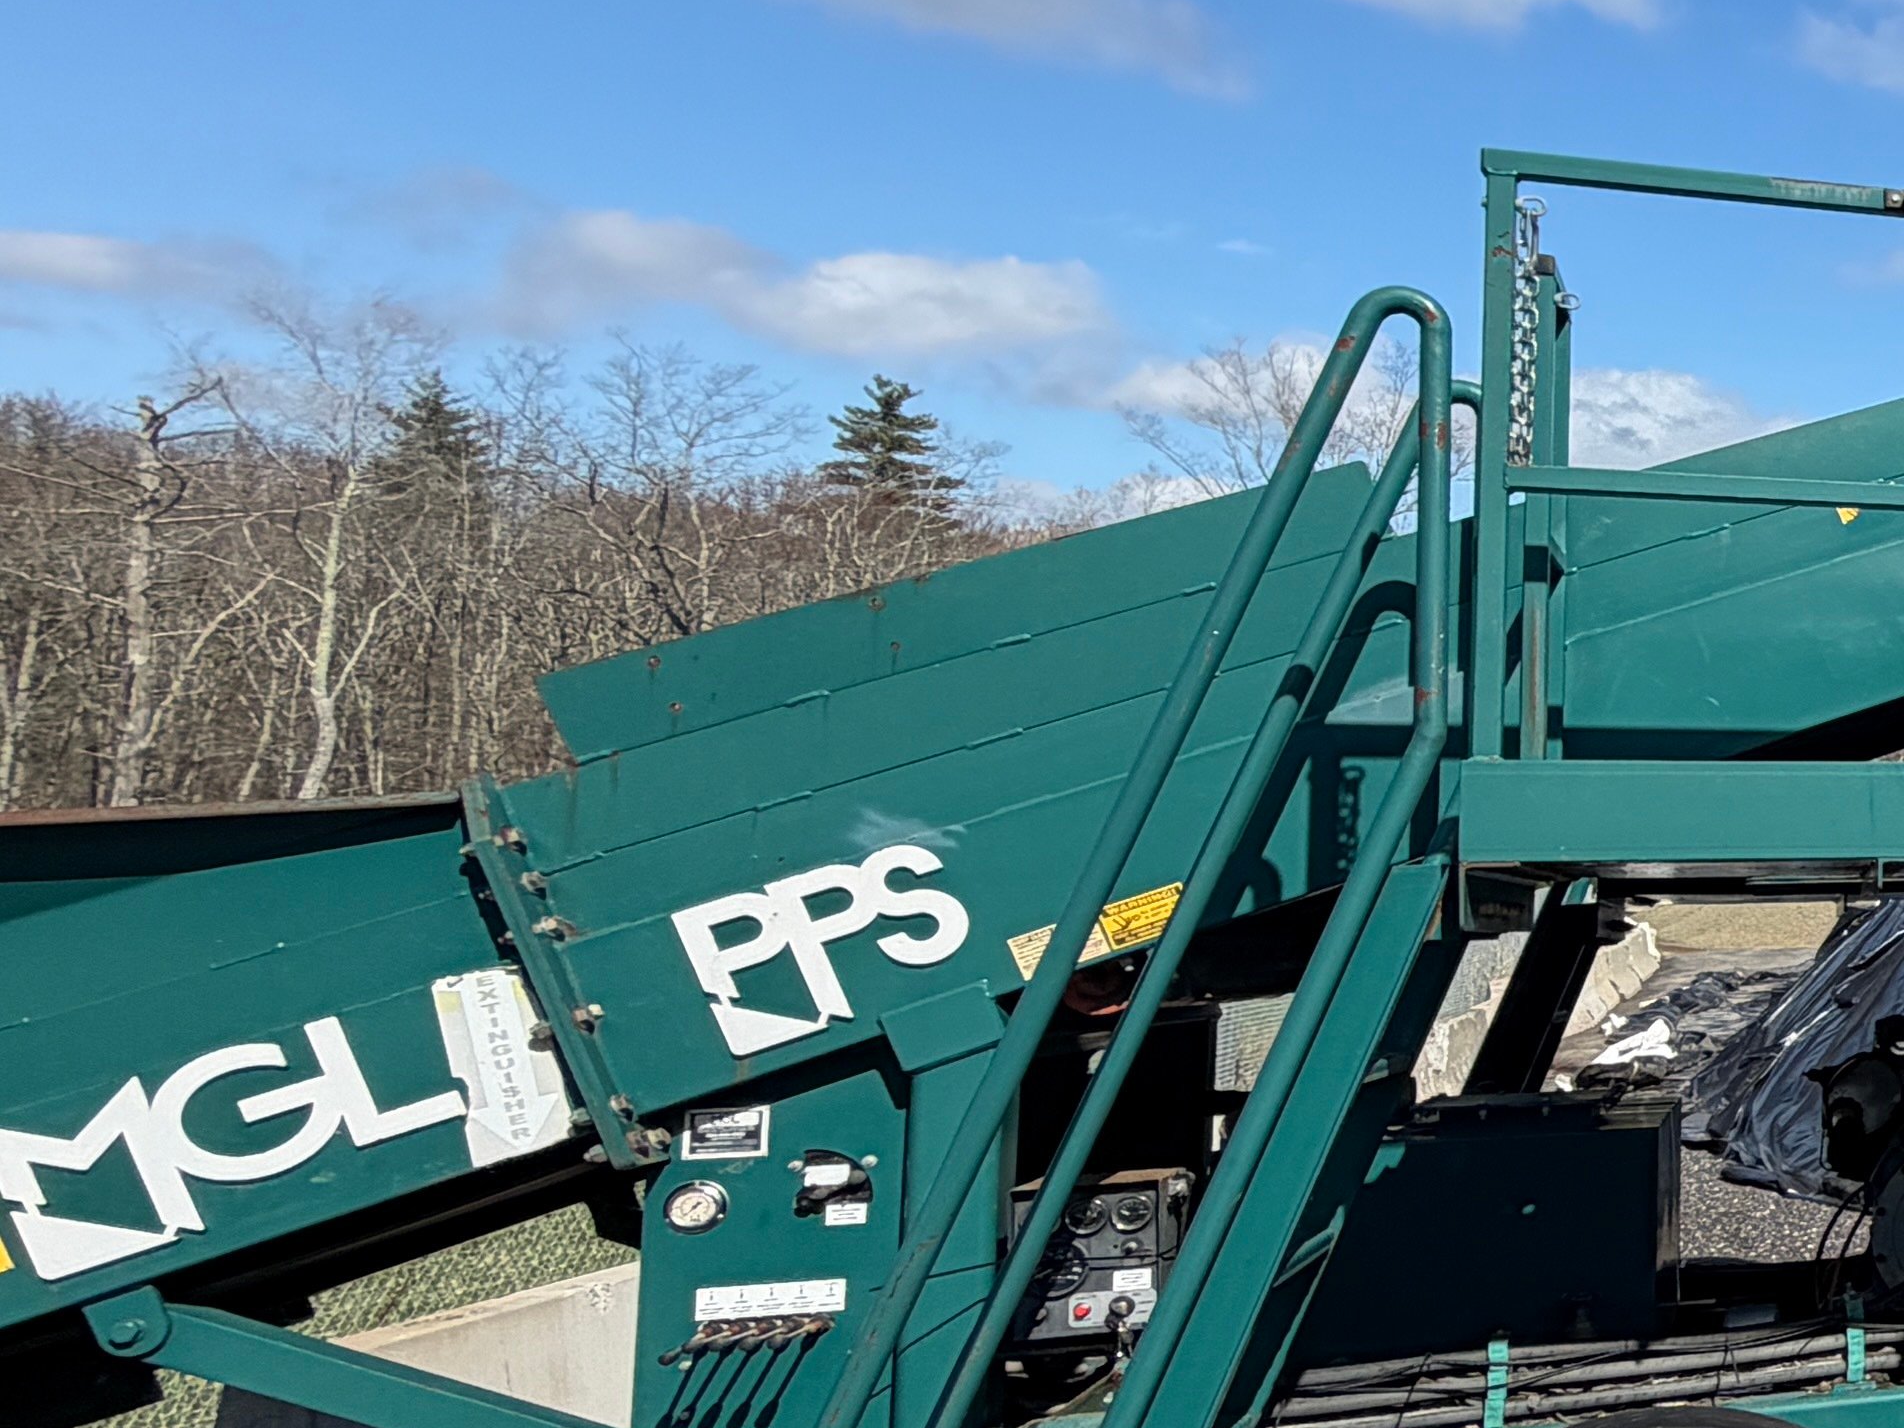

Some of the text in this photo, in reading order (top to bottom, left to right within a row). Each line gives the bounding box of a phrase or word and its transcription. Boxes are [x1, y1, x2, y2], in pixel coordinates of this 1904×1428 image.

[670, 845, 969, 1019] PPS
[0, 1016, 468, 1232] MGL
[475, 974, 532, 1140] EXTINGUISHER
